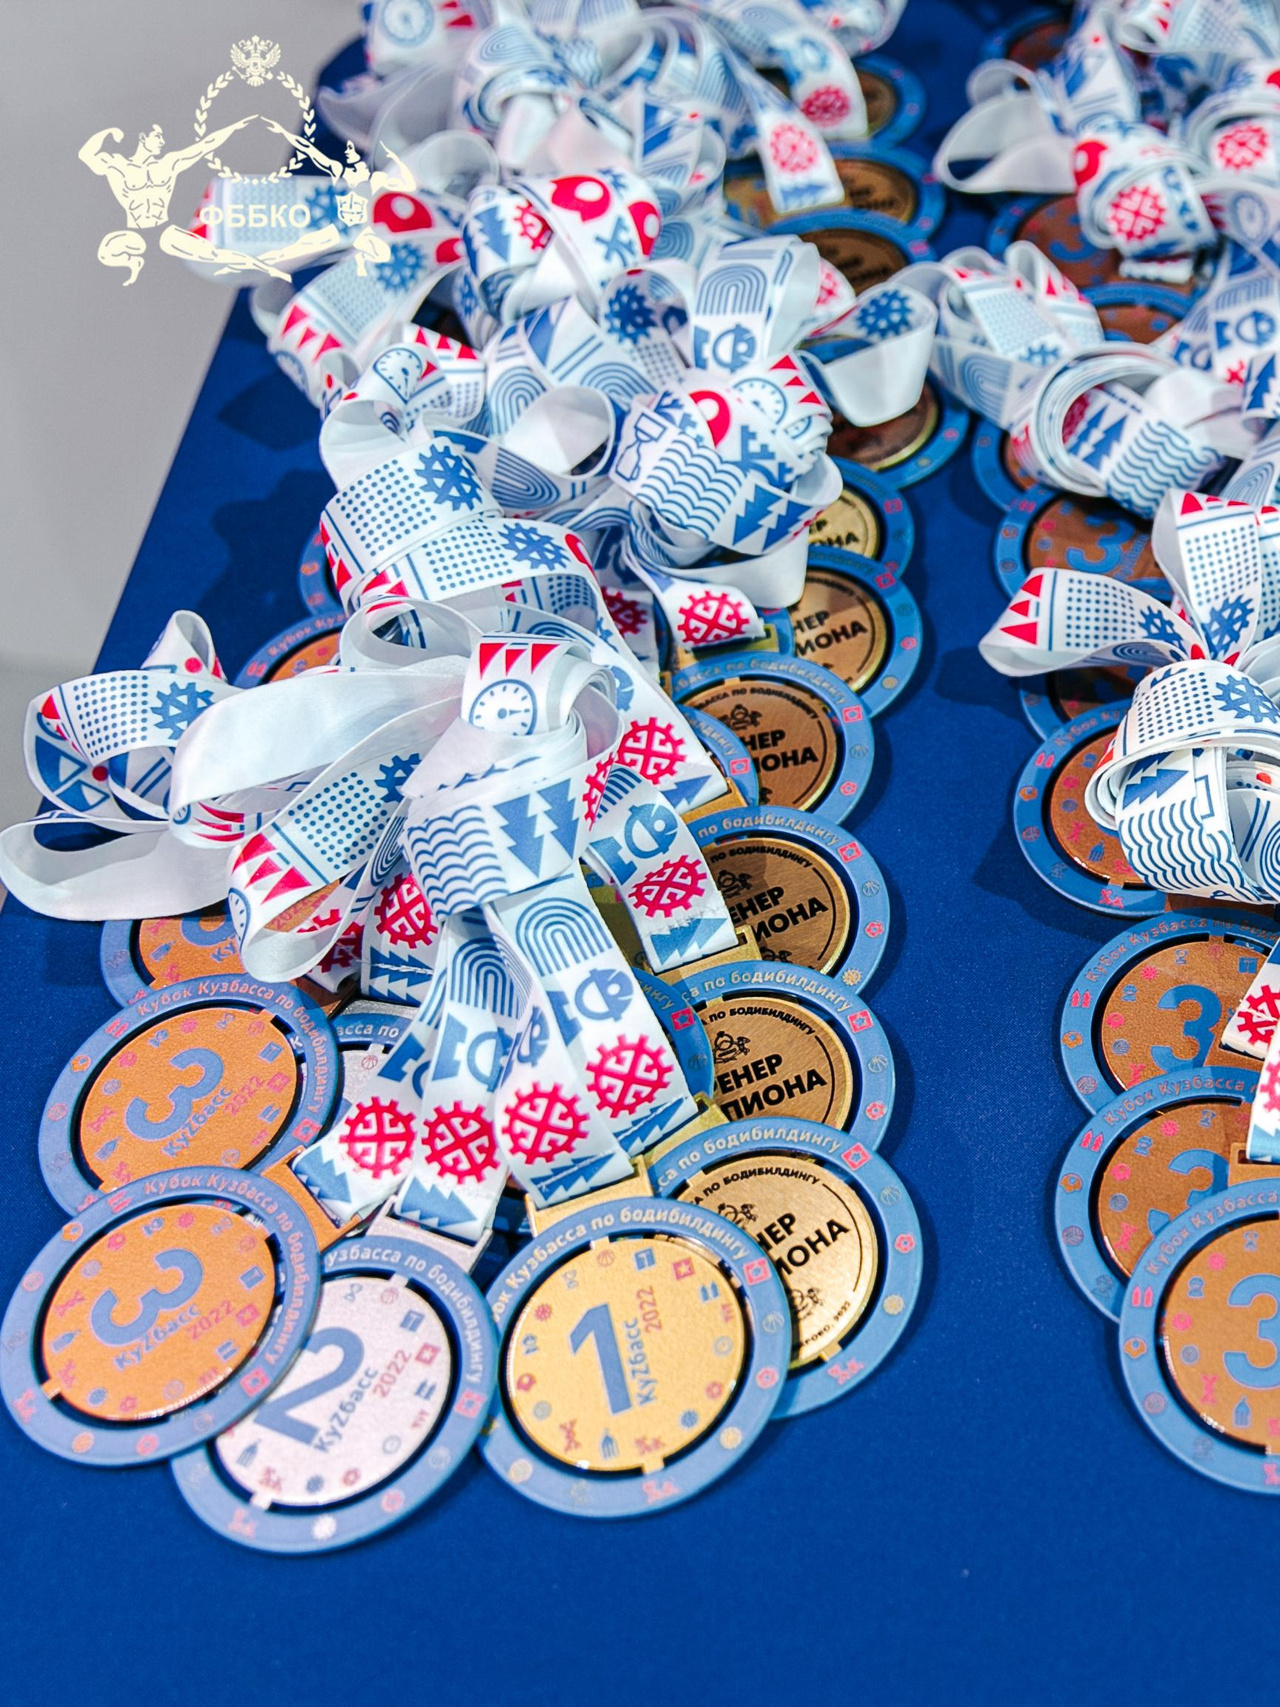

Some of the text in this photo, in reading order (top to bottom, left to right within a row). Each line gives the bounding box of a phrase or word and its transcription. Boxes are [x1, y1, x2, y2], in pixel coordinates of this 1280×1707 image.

[795, 610, 830, 633] НЕР
[795, 621, 868, 657] ИОНА
[698, 814, 841, 846] по бодибилдингу
[710, 845, 813, 869] ПО БОДИБИЛДИНГУ
[730, 886, 785, 924] ЕНЕР
[752, 897, 829, 942] ИОНА
[1084, 946, 1128, 982] Кубок
[1129, 917, 1208, 946] Кузбасса
[704, 977, 726, 993] по
[730, 971, 853, 1012] бодибилдингу
[337, 1024, 400, 1037] асса по
[709, 1006, 816, 1037] ПО БОДИБИЛДИНГУ
[1151, 984, 1222, 1073] 3
[137, 988, 193, 1016] Кубок
[198, 980, 275, 1000] Кузбасса
[274, 994, 294, 1010] по
[292, 1006, 328, 1113] бодибилдингу
[124, 1047, 224, 1142] 3
[224, 1075, 265, 1117] 2022
[721, 1068, 828, 1120] ПИОНА
[1102, 1076, 1245, 1126] Кубок Кузбасса
[677, 1126, 843, 1169] по бодибилдингу
[703, 1166, 822, 1198] ПО БОДИБИЛДИНГУ
[505, 1207, 749, 1290] Кузбасса по бодибилдингу
[756, 1212, 798, 1251] НЕР
[775, 1218, 851, 1276] ИОНА
[1145, 1227, 1191, 1276] Кубок
[1190, 1190, 1279, 1230] Кузбасса
[143, 1173, 310, 1366] Кубок Кузбасса по бодибилдингу
[90, 1248, 204, 1347] 3
[186, 1300, 236, 1341] 2022
[326, 1245, 403, 1267] узбасса
[404, 1256, 427, 1272] по
[427, 1264, 484, 1384] бодибилдингу
[636, 1285, 662, 1334] 2022
[372, 1349, 413, 1399] 2022
[569, 1302, 632, 1416] 1
[253, 1326, 365, 1446] 2
